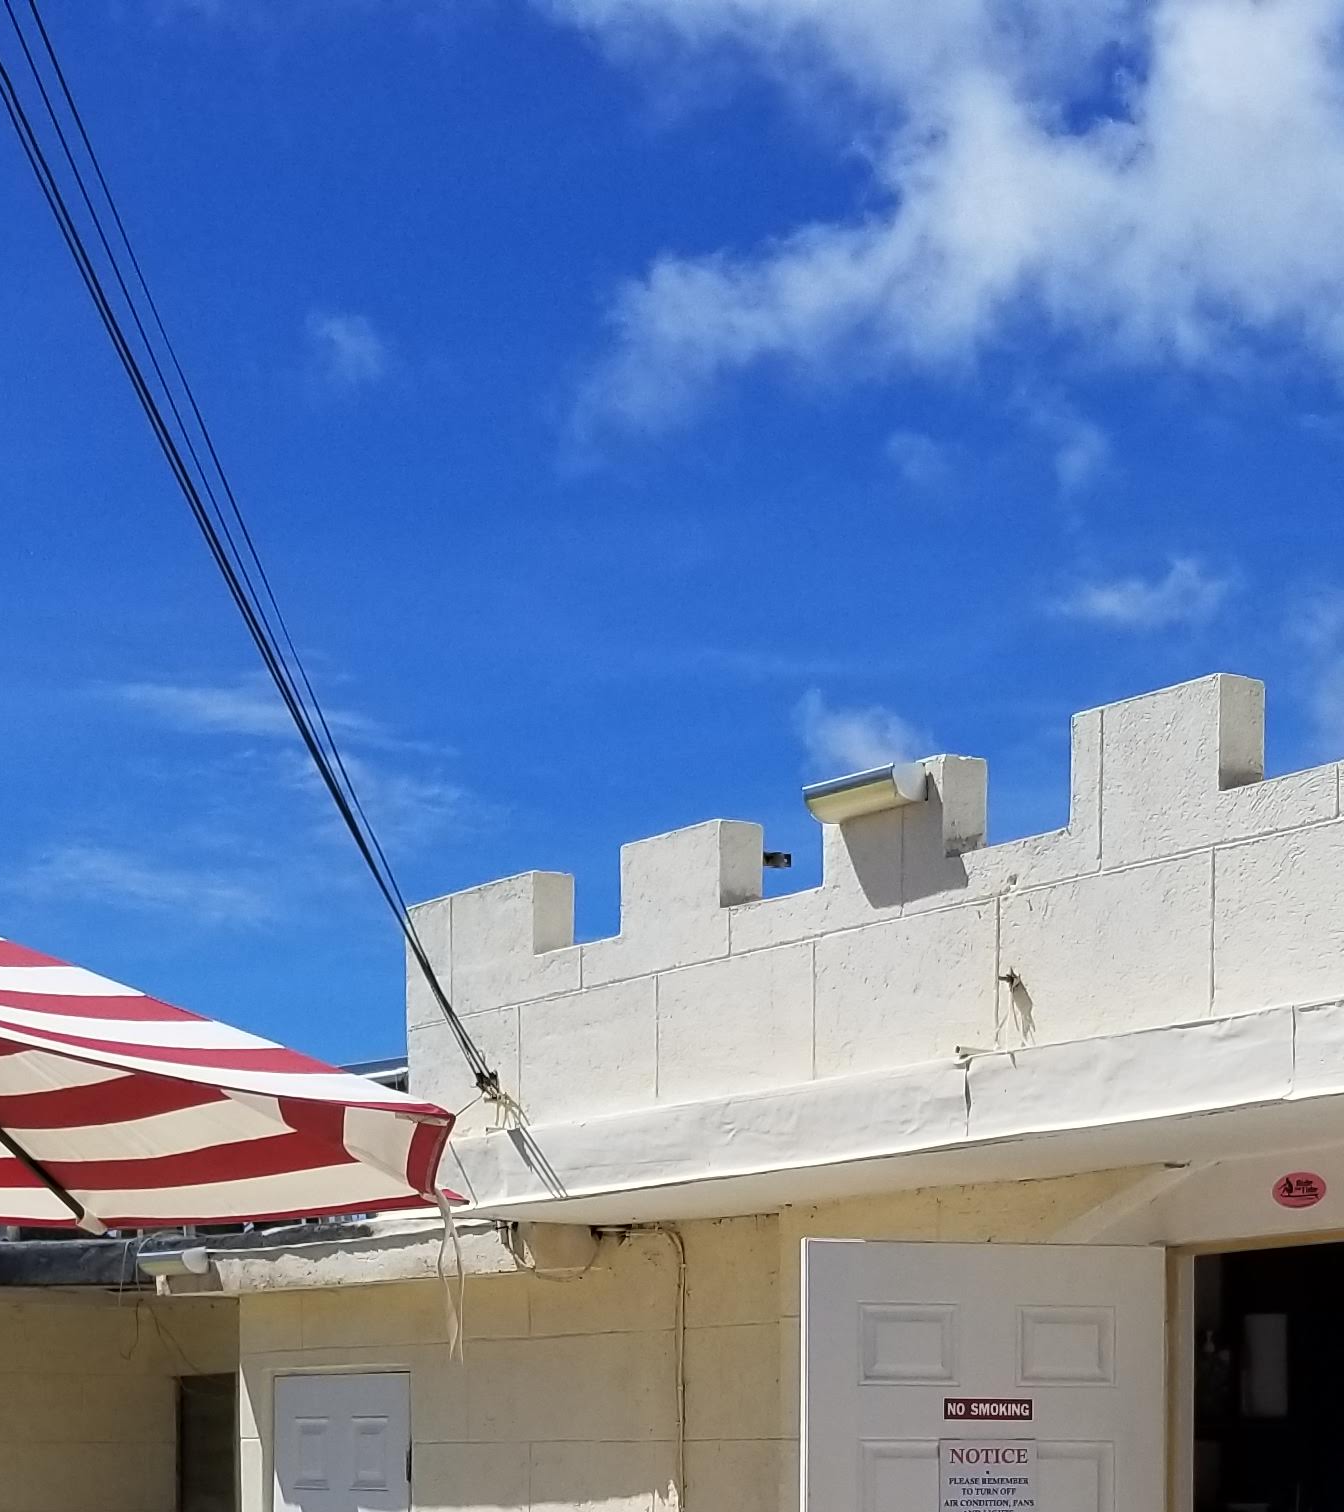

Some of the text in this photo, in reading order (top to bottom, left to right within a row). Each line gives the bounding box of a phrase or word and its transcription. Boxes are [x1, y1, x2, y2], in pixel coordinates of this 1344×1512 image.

[947, 1402, 1030, 1416] NO SMOKING
[949, 1448, 1029, 1464] NOTICE
[948, 1477, 1029, 1485] PLEASE REMEMBER
[961, 1488, 1017, 1496] TO TURN OFF
[944, 1499, 1035, 1508] AIR CONDITION, FANS
